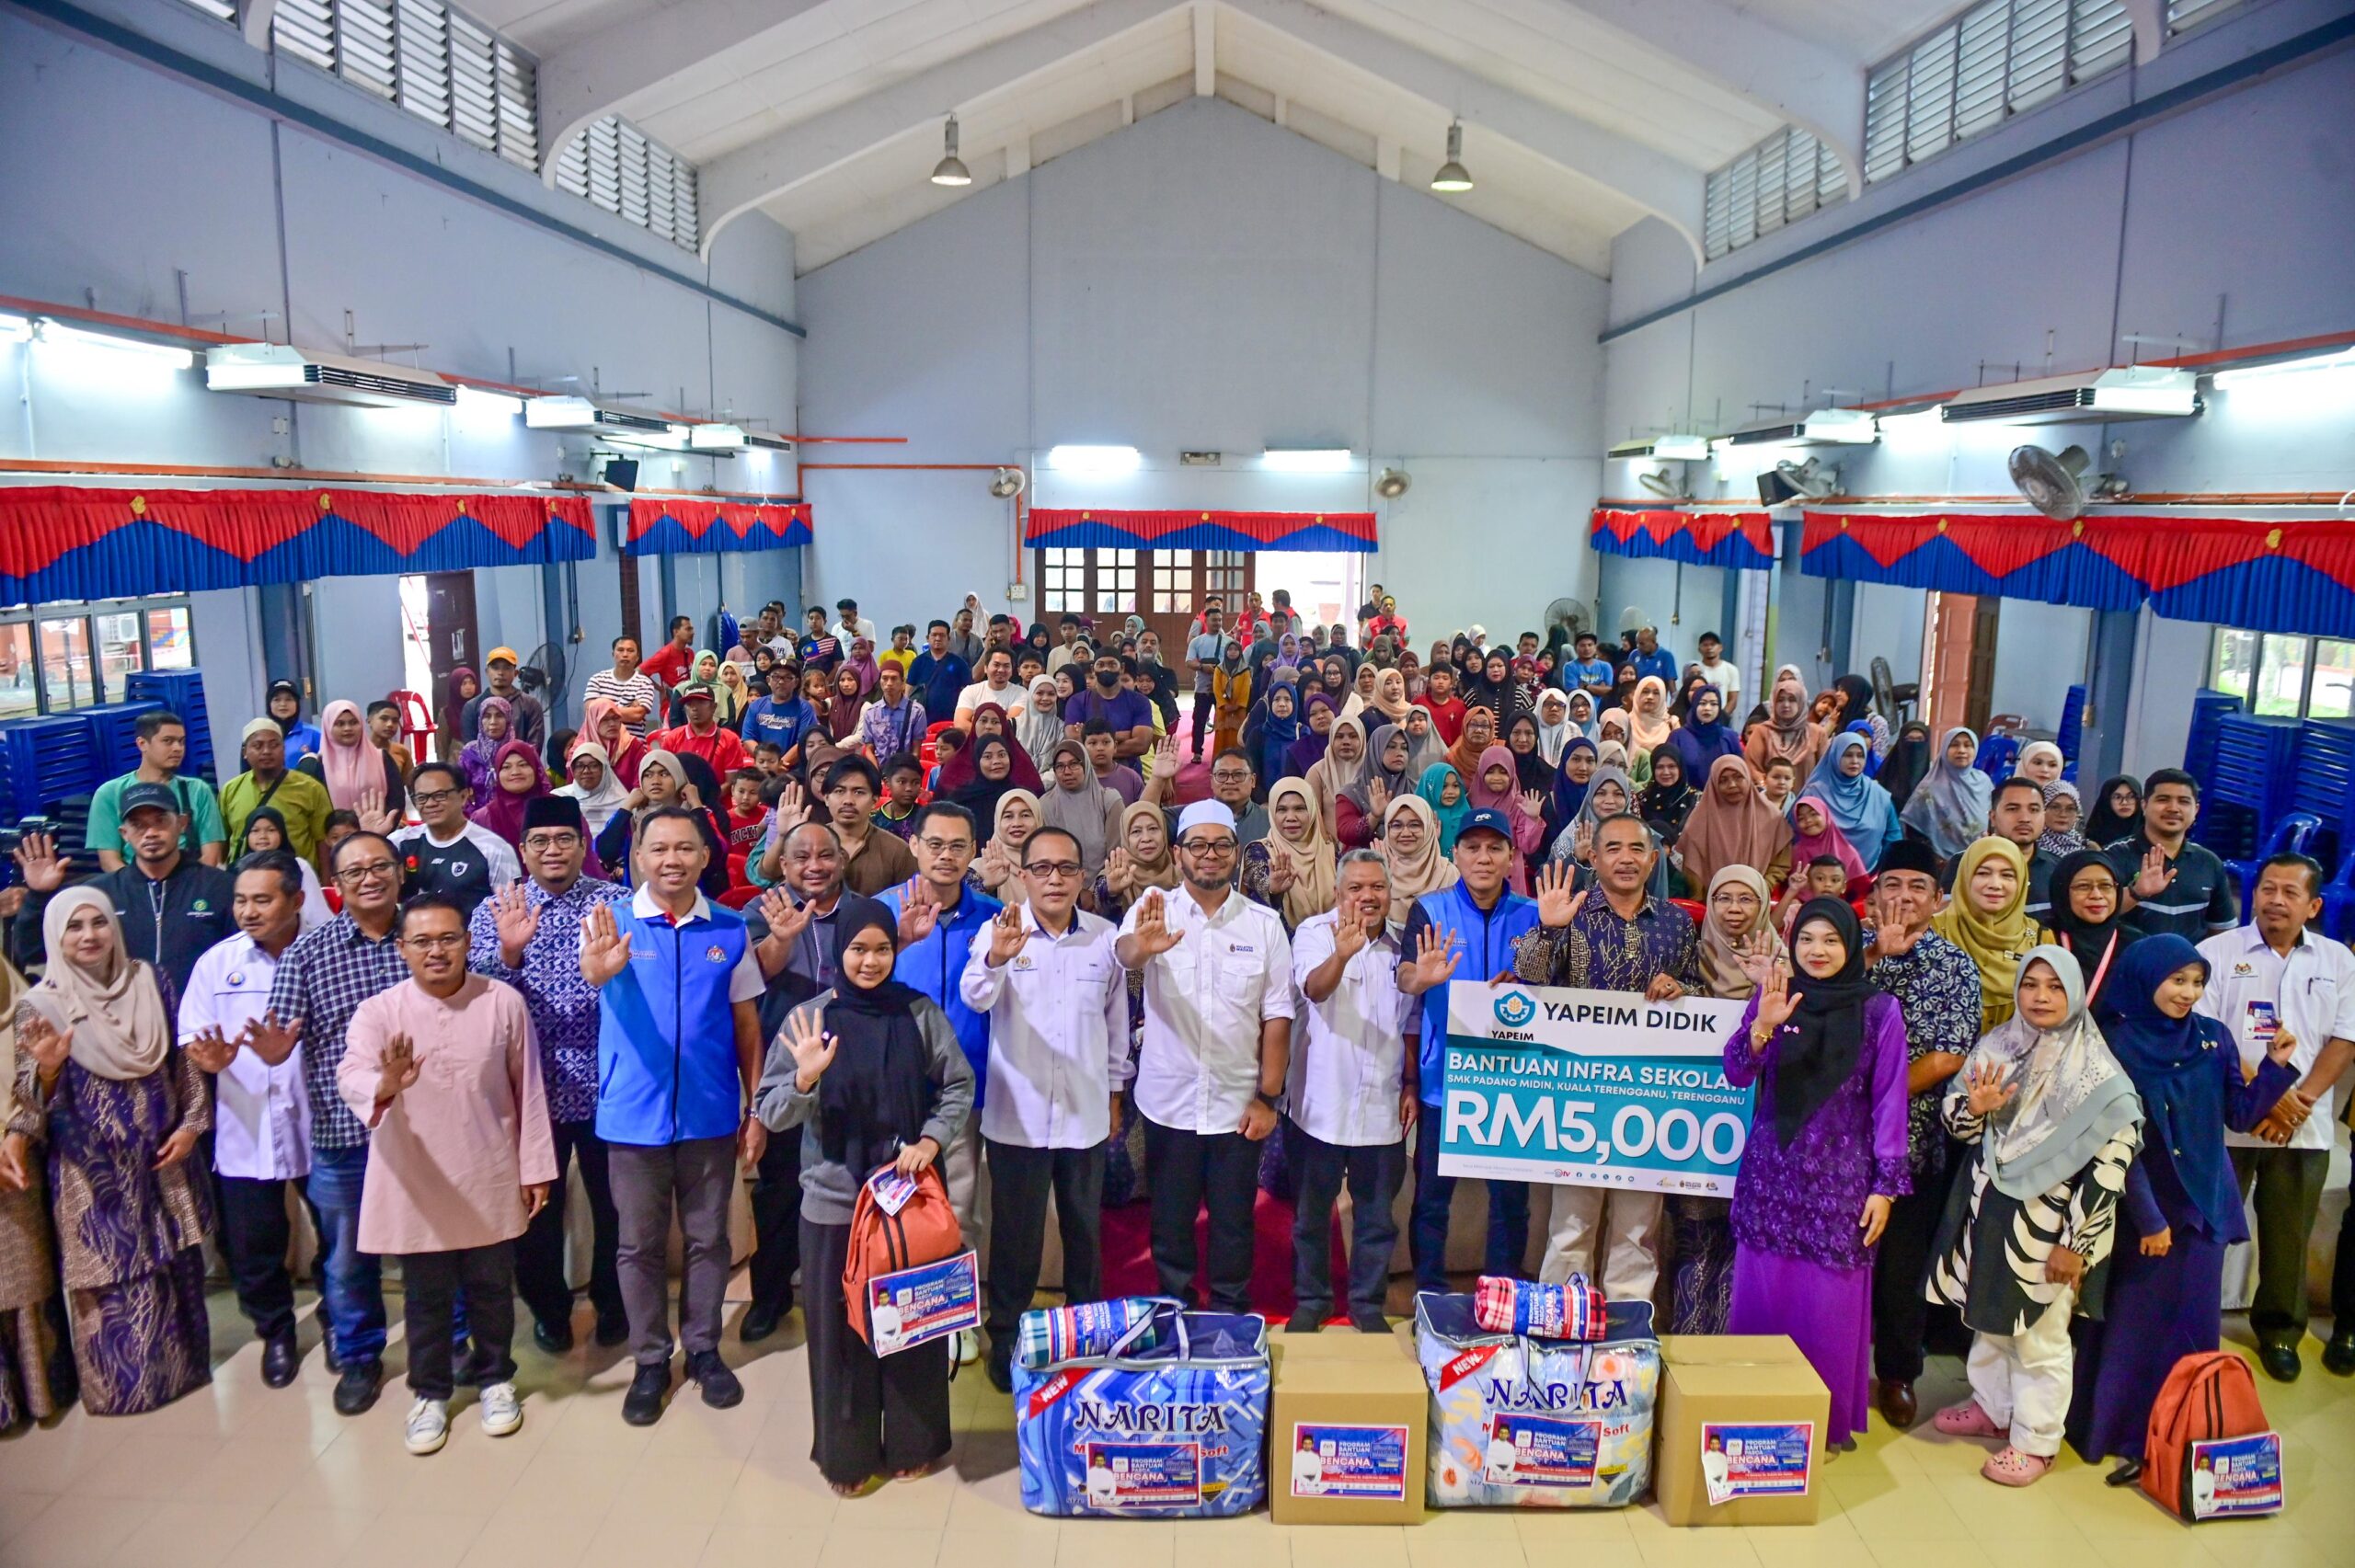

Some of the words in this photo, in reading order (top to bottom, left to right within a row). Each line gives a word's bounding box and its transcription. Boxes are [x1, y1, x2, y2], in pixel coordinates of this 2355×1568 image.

[1544, 1002, 1637, 1027] YAPEIM
[1646, 1009, 1717, 1033] DIDIK
[1492, 1030, 1534, 1042] YAPEIM
[1449, 1052, 1559, 1078] BANTUAN
[1566, 1060, 1634, 1083] INFRA
[1640, 1068, 1747, 1092] SEKOLA
[1447, 1075, 1470, 1085] SMK
[1473, 1076, 1517, 1088] PADANG
[1520, 1079, 1554, 1092] MIDIN,
[1557, 1082, 1592, 1093] KUALA
[1595, 1084, 1669, 1100] TERENGGANU,
[1672, 1090, 1746, 1105] TERENGGANU
[1444, 1089, 1746, 1165] RM5,000
[898, 1295, 945, 1315] BENCANA
[1544, 1292, 1553, 1334] ENCANA
[1452, 1353, 1482, 1376] NEW
[1040, 1374, 1068, 1402] NEW
[1074, 1401, 1226, 1433] NARITA
[1535, 1431, 1566, 1441] PROGRAM
[1603, 1424, 1630, 1437] Soft
[1534, 1437, 1566, 1446] BANTUAN
[1321, 1457, 1371, 1466] BENCANA
[1515, 1448, 1565, 1459] BENCANA
[1727, 1455, 1776, 1465] BENCANA
